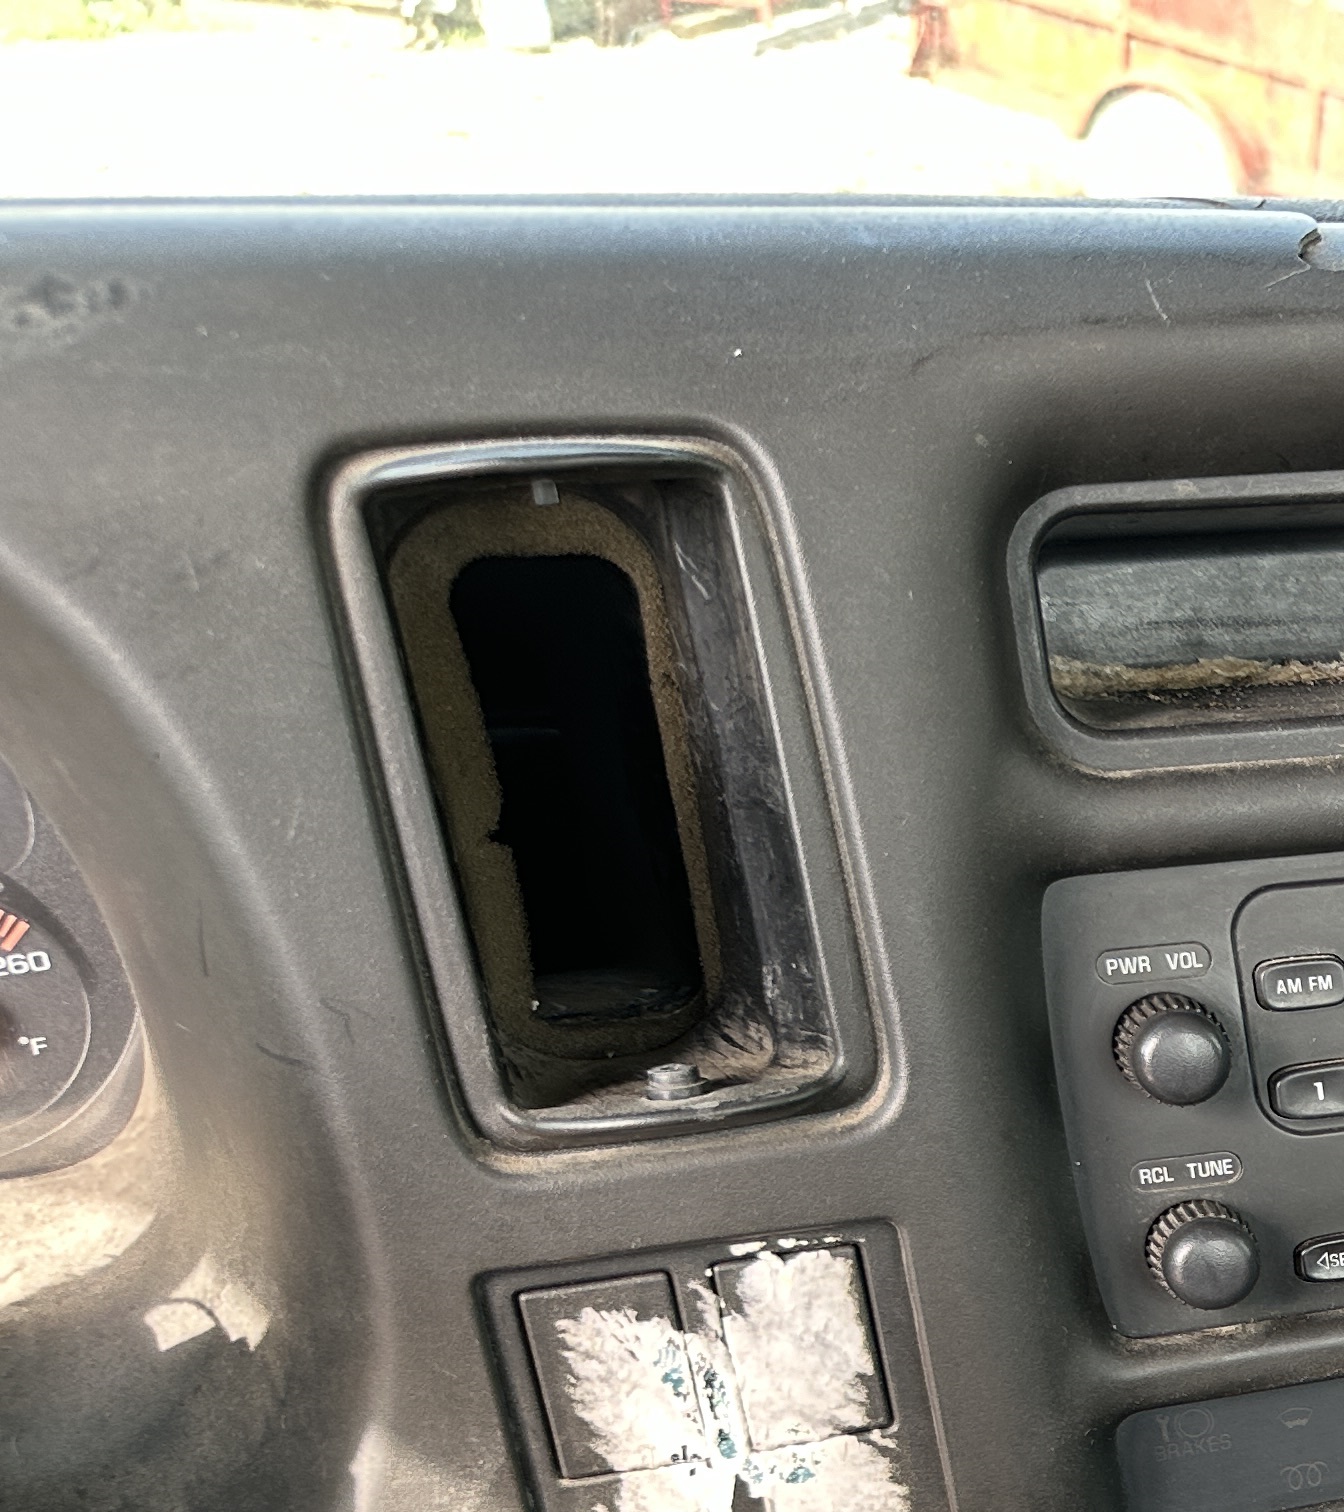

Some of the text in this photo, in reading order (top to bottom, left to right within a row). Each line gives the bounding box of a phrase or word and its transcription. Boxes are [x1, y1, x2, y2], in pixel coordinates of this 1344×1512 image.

[1105, 951, 1204, 977] PWR VOL
[1276, 974, 1334, 995] AM FM
[1312, 1081, 1325, 1101] 1
[1138, 1158, 1235, 1185] RCL TUNE
[1155, 1433, 1233, 1462] BRAKES
